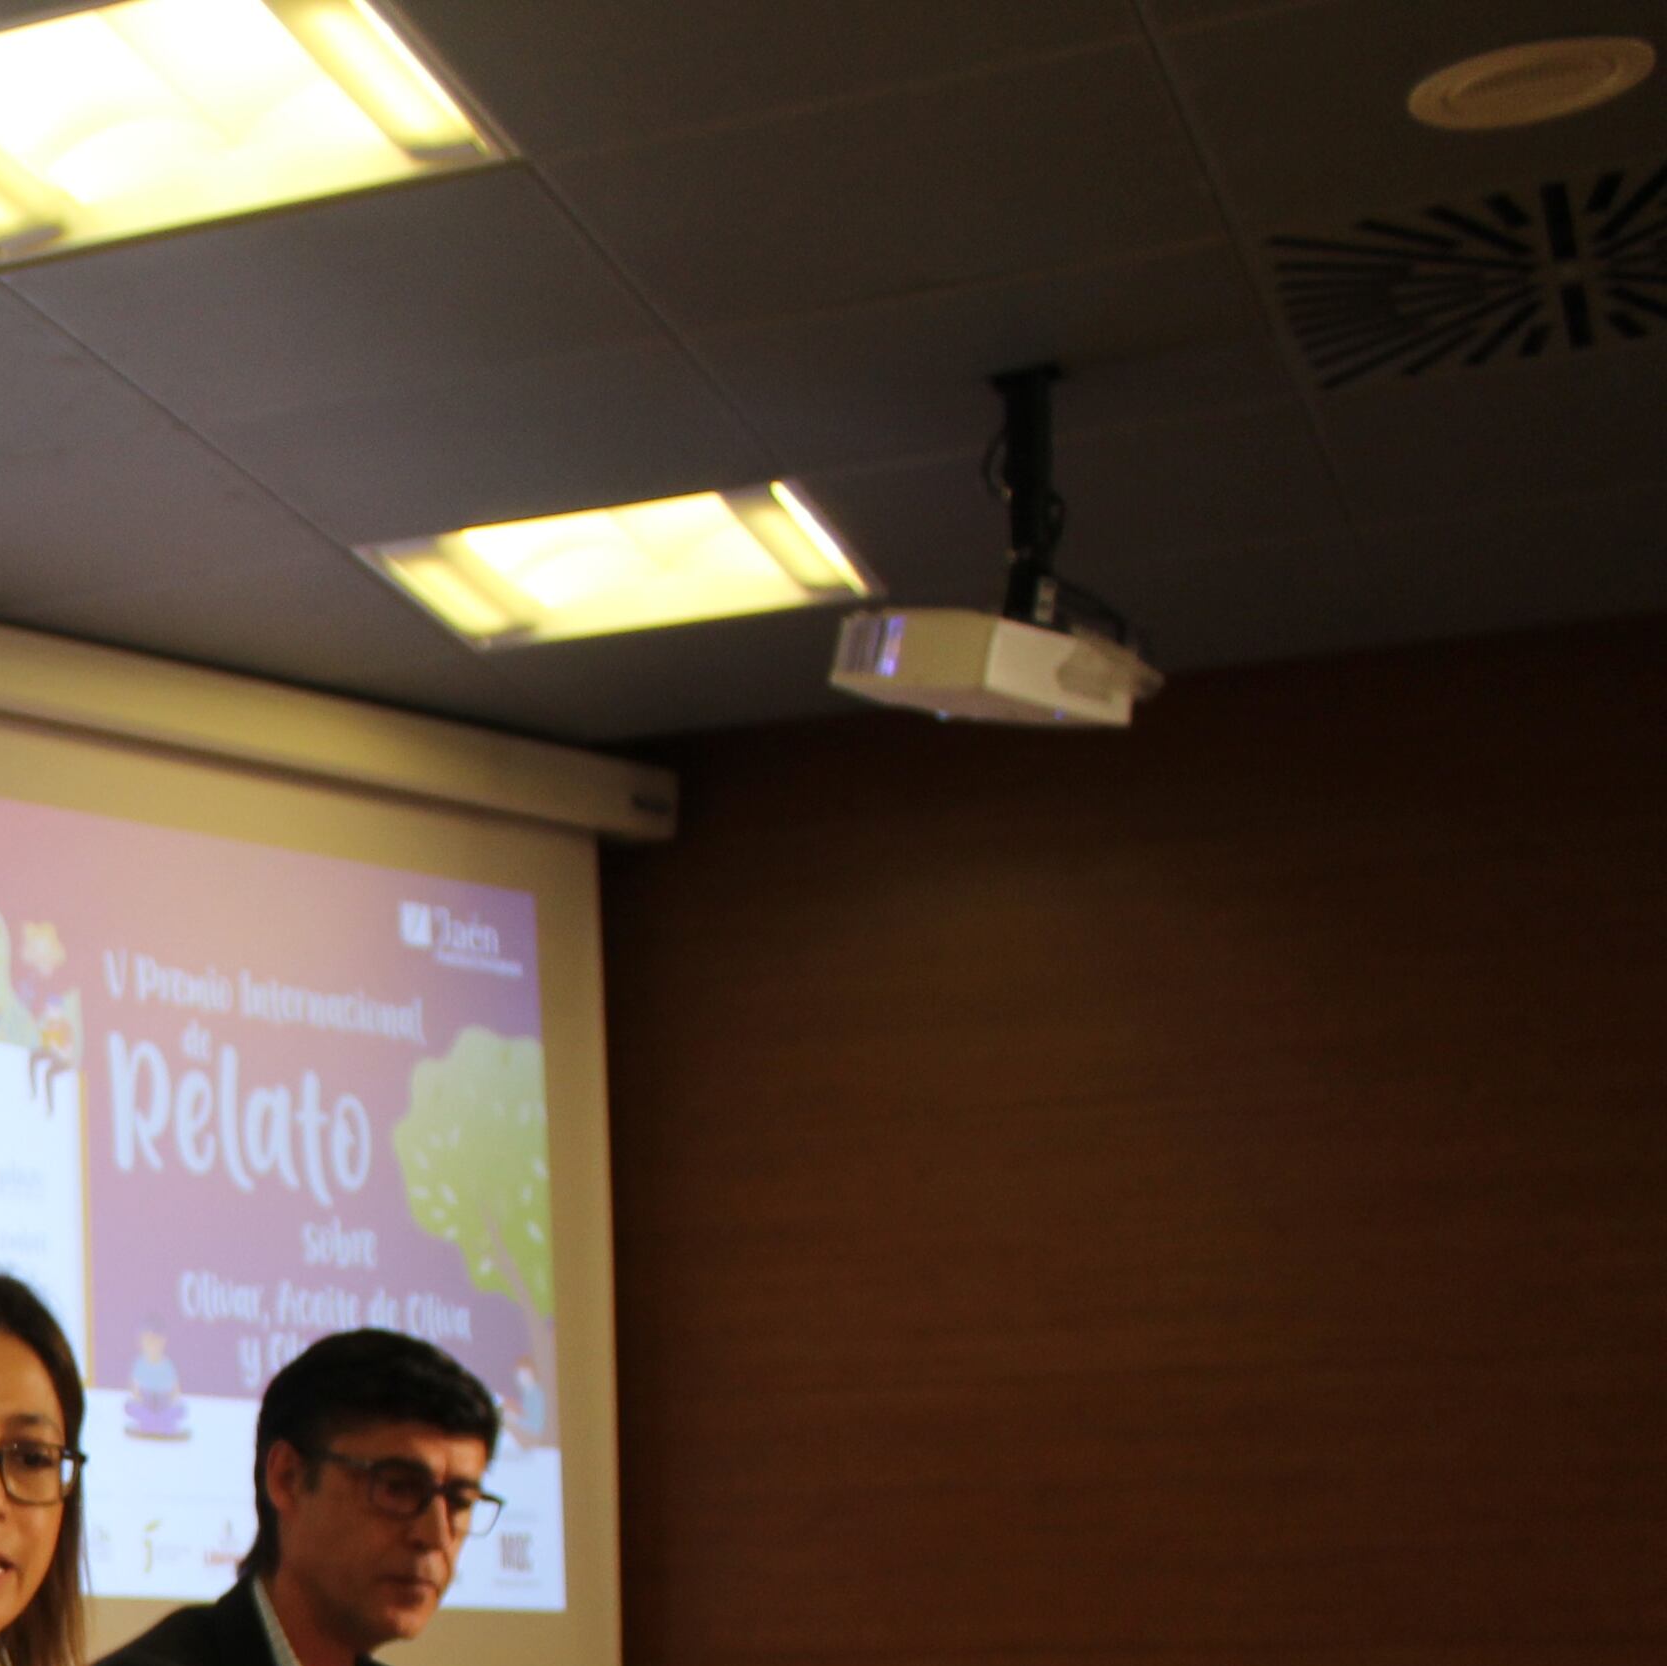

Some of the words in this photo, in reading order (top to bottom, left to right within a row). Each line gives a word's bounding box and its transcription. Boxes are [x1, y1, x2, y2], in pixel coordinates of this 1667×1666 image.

[432, 904, 500, 954] Jaén
[103, 947, 128, 1001] V
[134, 953, 234, 1015] Premio
[238, 968, 427, 1046] Internacional
[107, 1030, 373, 1208] Relato
